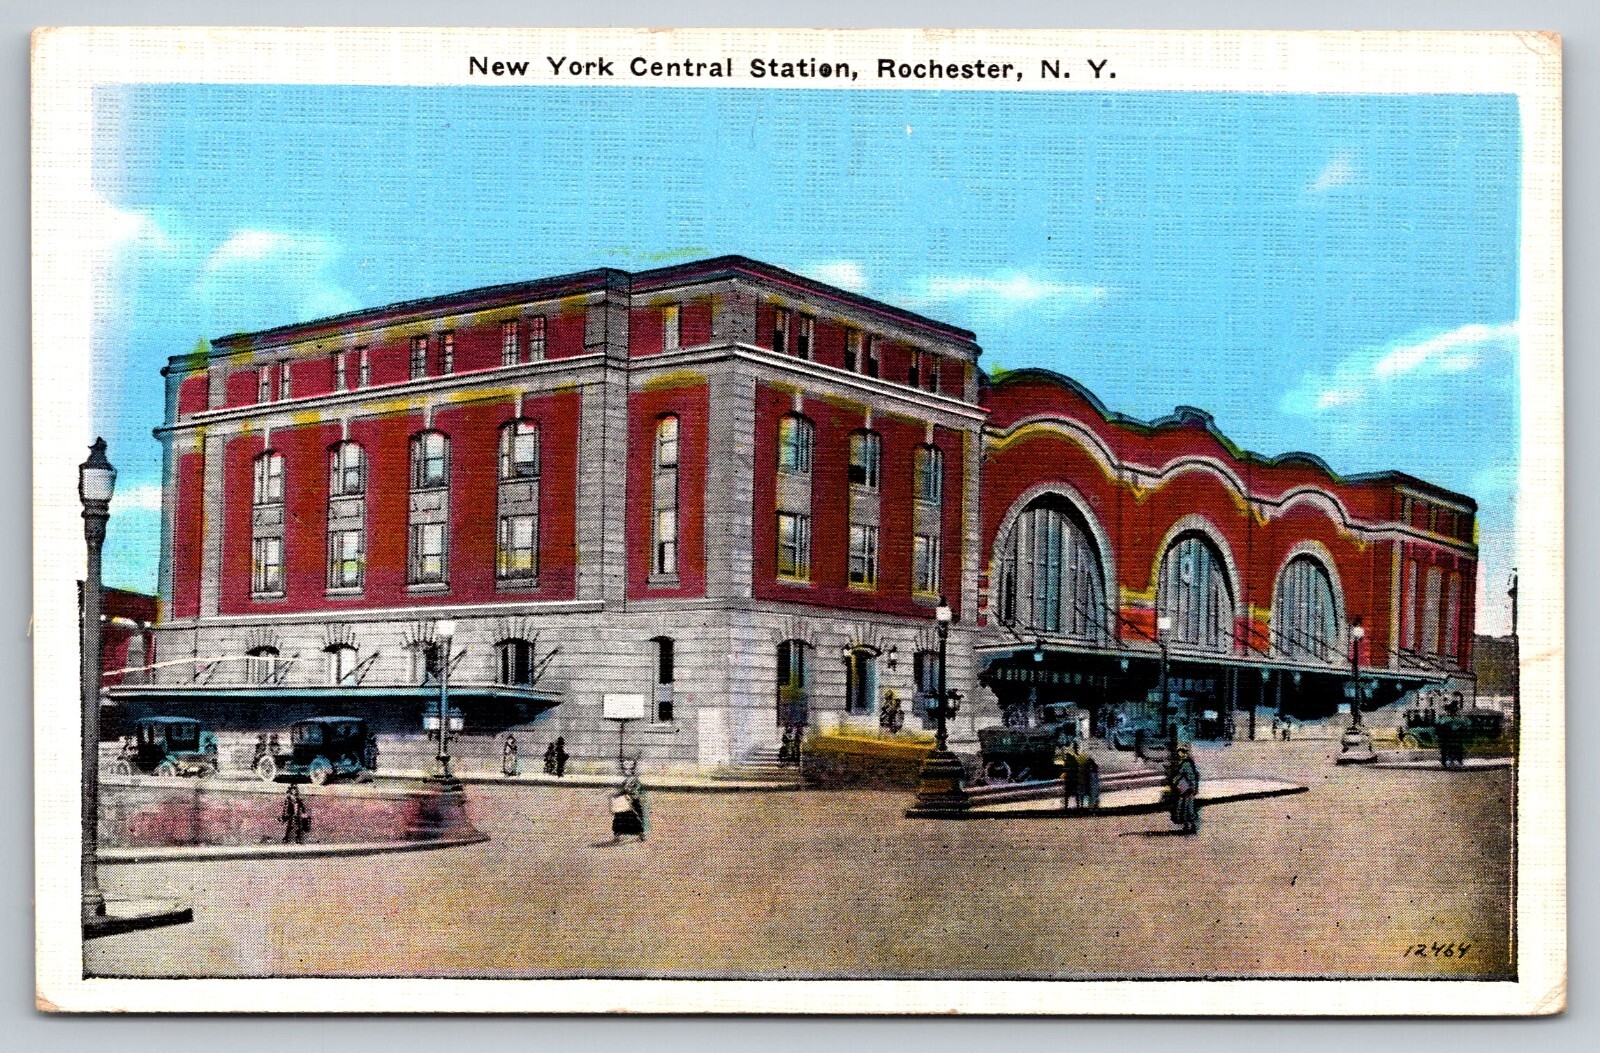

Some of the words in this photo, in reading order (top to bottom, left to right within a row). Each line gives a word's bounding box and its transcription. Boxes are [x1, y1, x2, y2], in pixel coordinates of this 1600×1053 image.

[469, 56, 530, 76] New
[546, 56, 614, 76] York
[630, 56, 732, 78] Central
[749, 57, 858, 82] Station,
[877, 58, 1023, 82] Rochester,
[1041, 59, 1070, 79] N.
[1087, 59, 1116, 79] Y.
[1403, 941, 1473, 959] 12464
